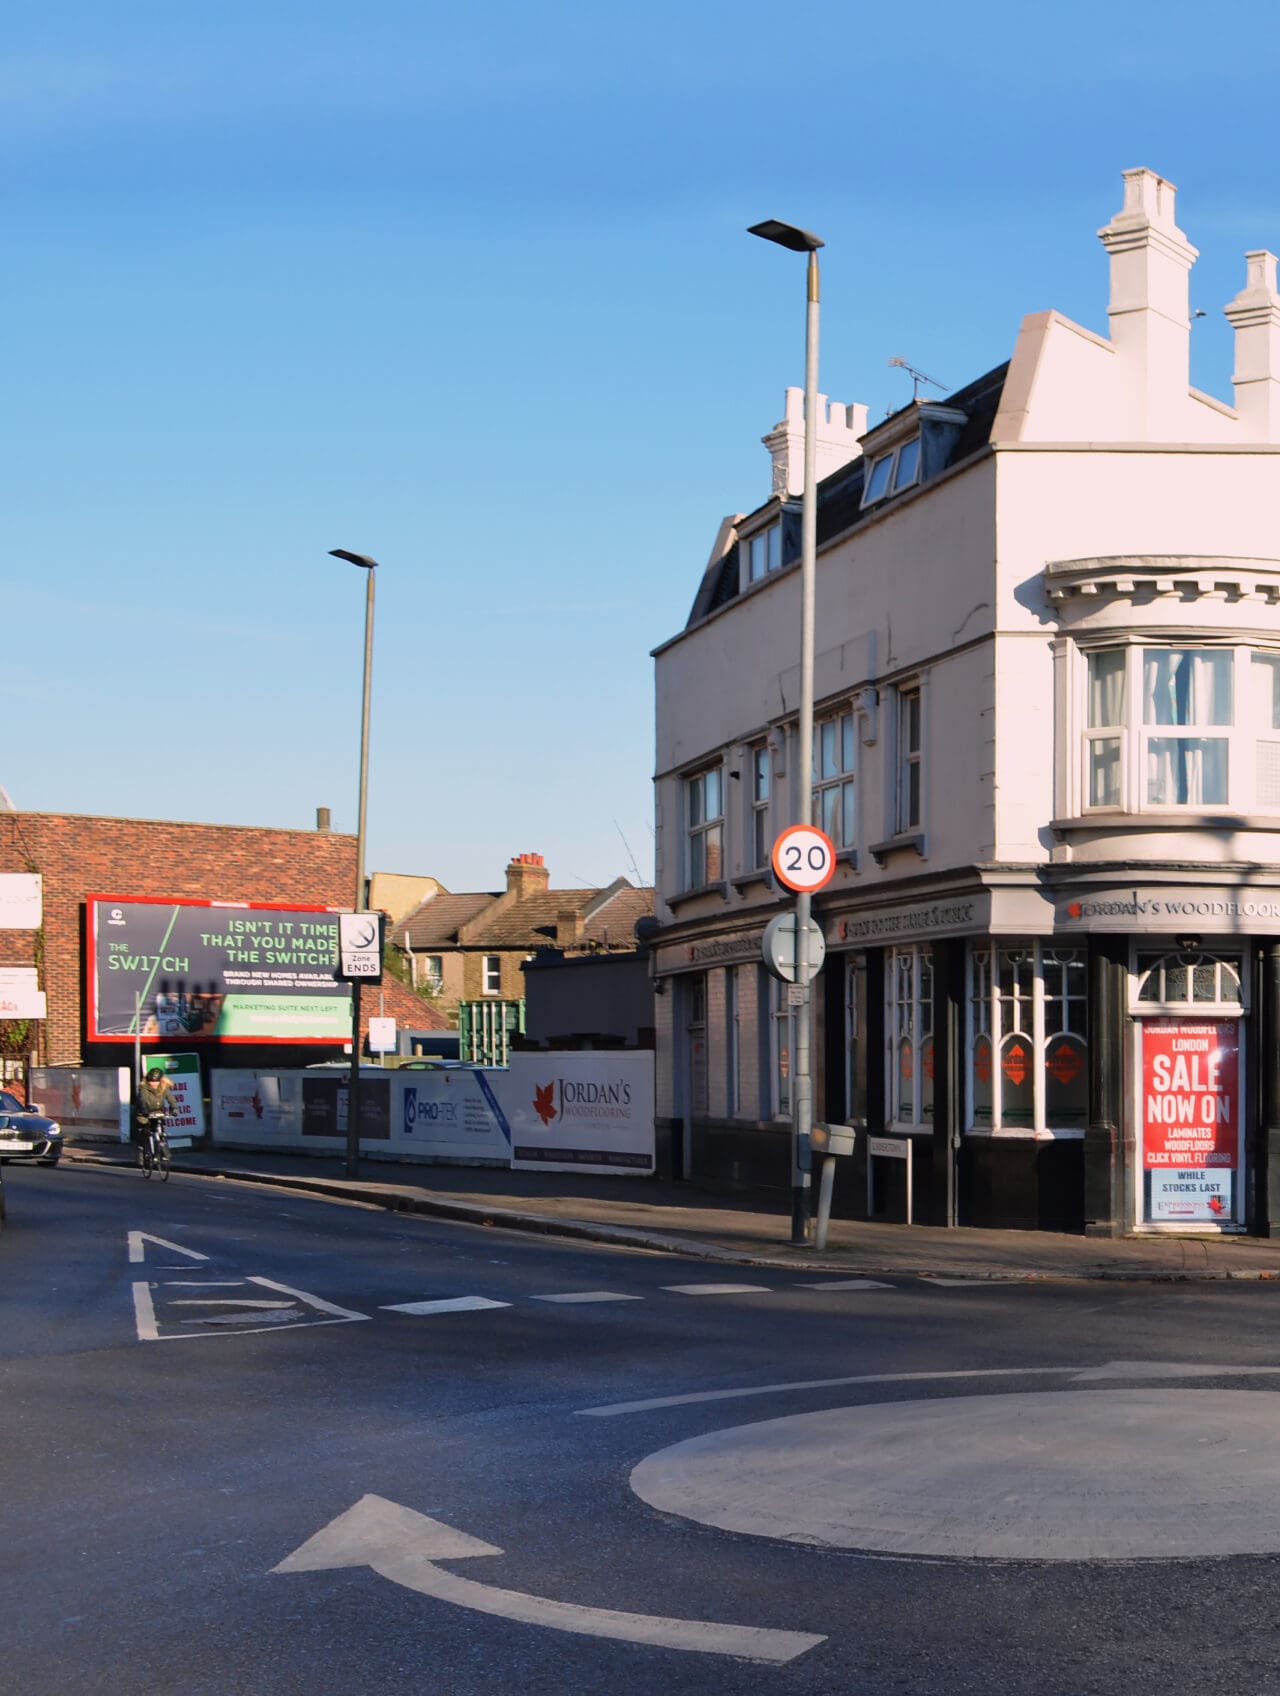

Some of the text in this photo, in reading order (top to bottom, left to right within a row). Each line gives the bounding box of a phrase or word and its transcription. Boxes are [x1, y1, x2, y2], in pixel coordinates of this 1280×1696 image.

[785, 845, 826, 871] 20
[228, 920, 337, 936] ISN'T IT TIME
[108, 943, 129, 952] THE
[200, 934, 337, 950] THAT YOU MADE
[227, 950, 259, 963] THE
[347, 963, 377, 973] ENDS
[1171, 1038, 1209, 1052] LONDON
[1152, 1054, 1223, 1092] SALE
[558, 1078, 631, 1122] JORDAN'S
[417, 1102, 458, 1120] PRO-TEK
[1147, 1094, 1230, 1124] NOW ON
[1168, 1127, 1213, 1139] LAMINATES
[1164, 1140, 1215, 1151] WOODFLOORS
[1147, 1152, 1231, 1163] CLICK VINYL FLOORING
[1177, 1171, 1206, 1180] WHILE
[1162, 1184, 1221, 1193] STOCKS LAST
